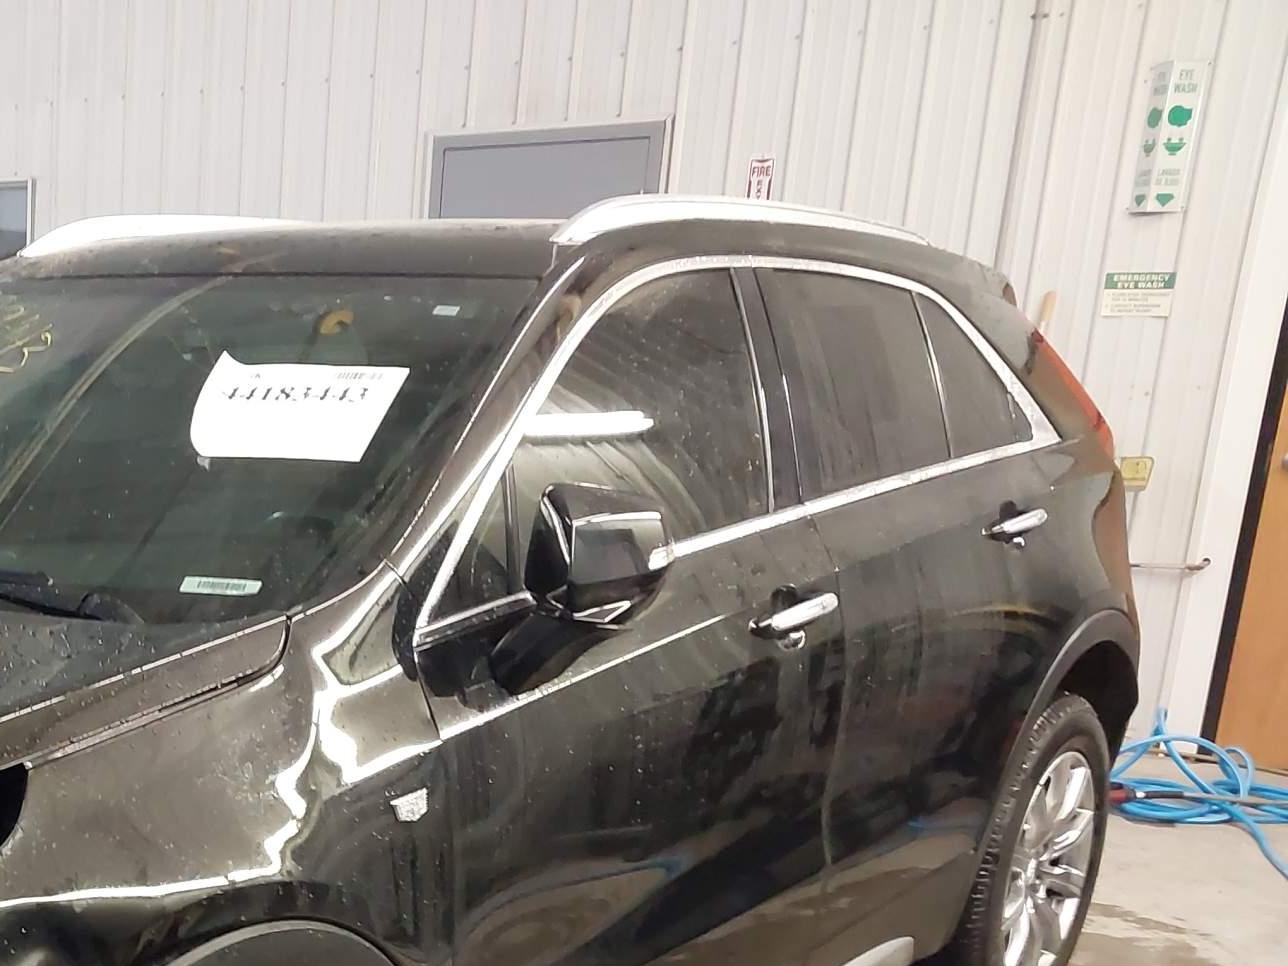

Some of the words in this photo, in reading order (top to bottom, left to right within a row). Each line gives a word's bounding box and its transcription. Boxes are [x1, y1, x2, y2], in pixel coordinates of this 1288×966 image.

[1179, 68, 1195, 81] EYE
[1174, 83, 1198, 93] WASH
[753, 166, 772, 177] FIRE
[1114, 274, 1170, 282] EMERGENCY
[221, 385, 370, 402] 44183443
